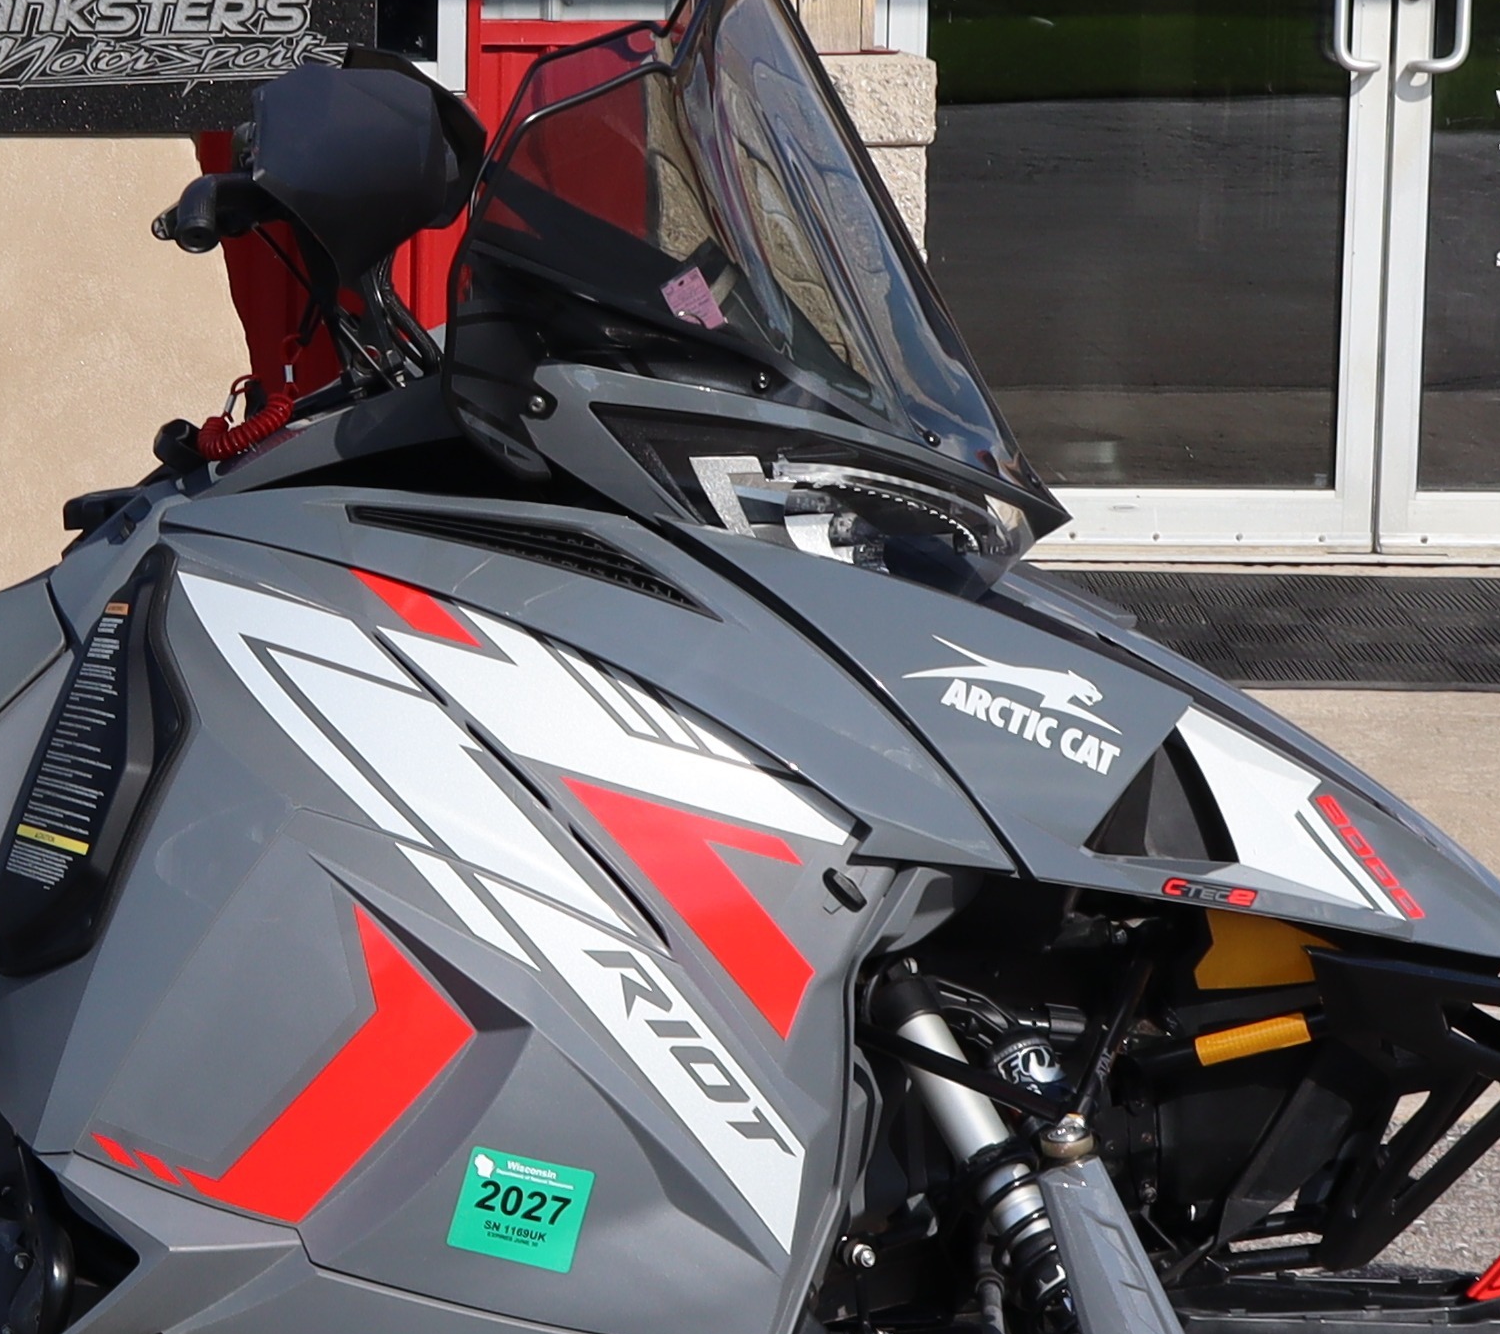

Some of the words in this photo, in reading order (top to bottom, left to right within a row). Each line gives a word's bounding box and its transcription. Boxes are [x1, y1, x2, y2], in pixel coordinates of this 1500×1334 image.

[940, 678, 1059, 749] ARCTIC
[1059, 727, 1121, 776] CAT
[1314, 794, 1427, 920] 8000
[1162, 876, 1259, 907] C-TEC2
[581, 948, 798, 1158] RIOT
[506, 1160, 558, 1180] Wisconsin
[474, 1180, 572, 1226] 2027
[483, 1219, 501, 1232] SN
[504, 1225, 547, 1242] 1169UK
